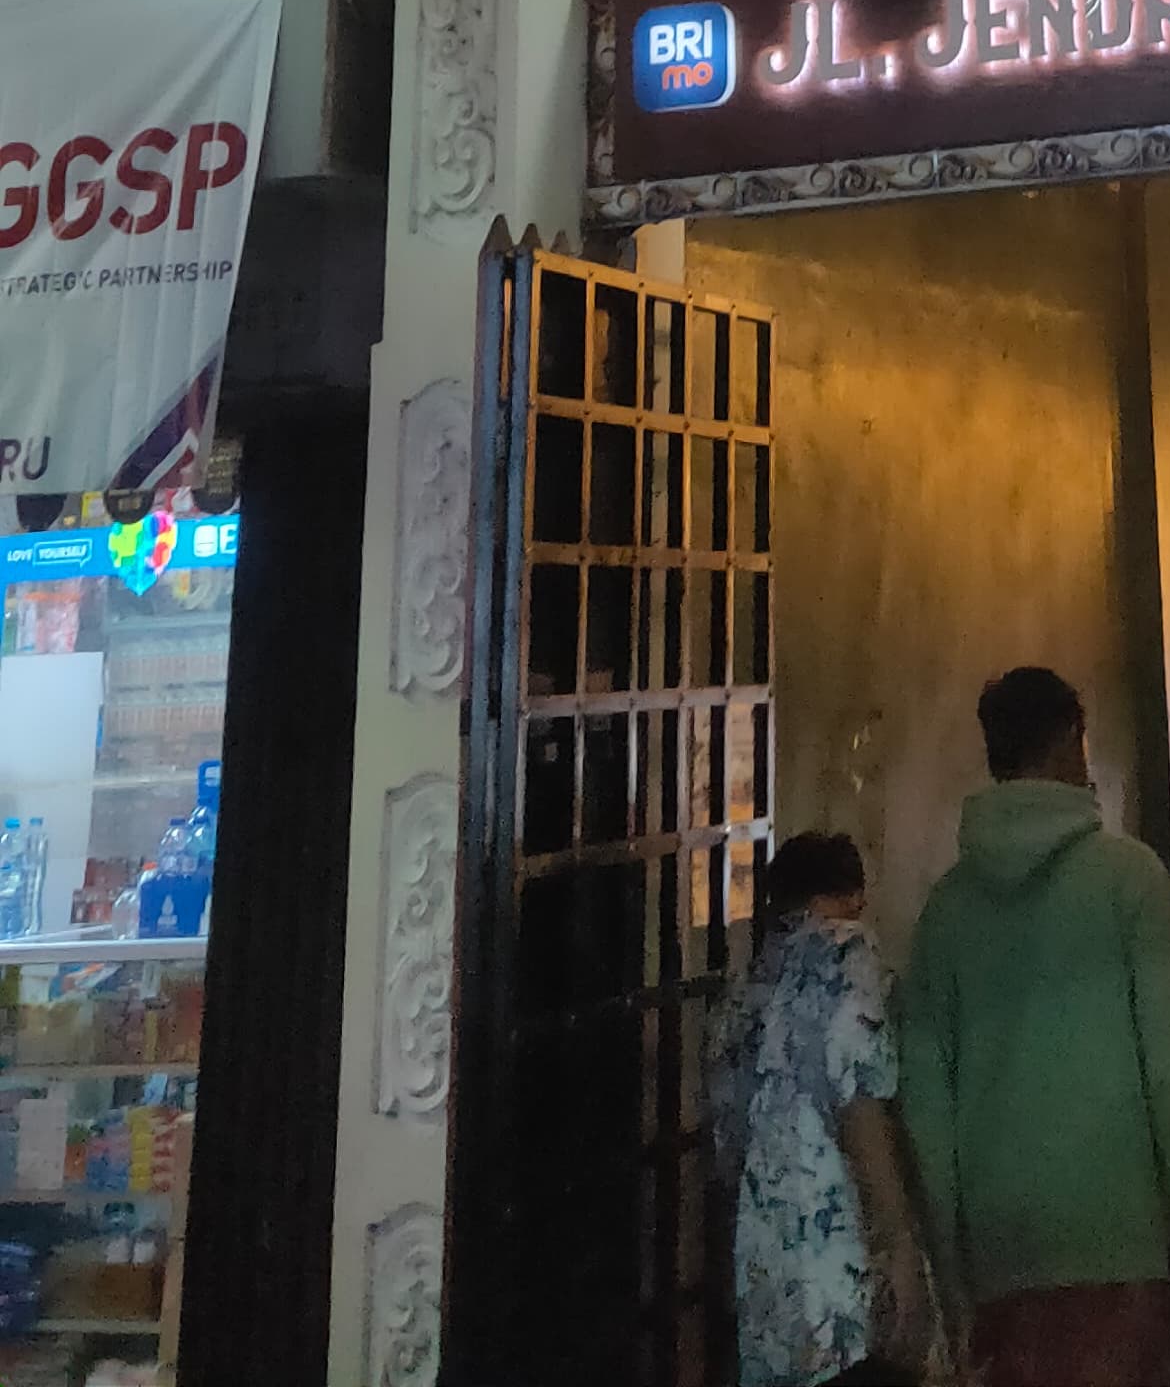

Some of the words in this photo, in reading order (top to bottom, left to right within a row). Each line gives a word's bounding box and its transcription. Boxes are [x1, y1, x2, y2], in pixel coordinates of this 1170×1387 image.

[649, 19, 712, 65] BRI
[757, 0, 889, 85] JL.
[662, 61, 714, 91] mo
[99, 260, 233, 290] PARTNERSHIP
